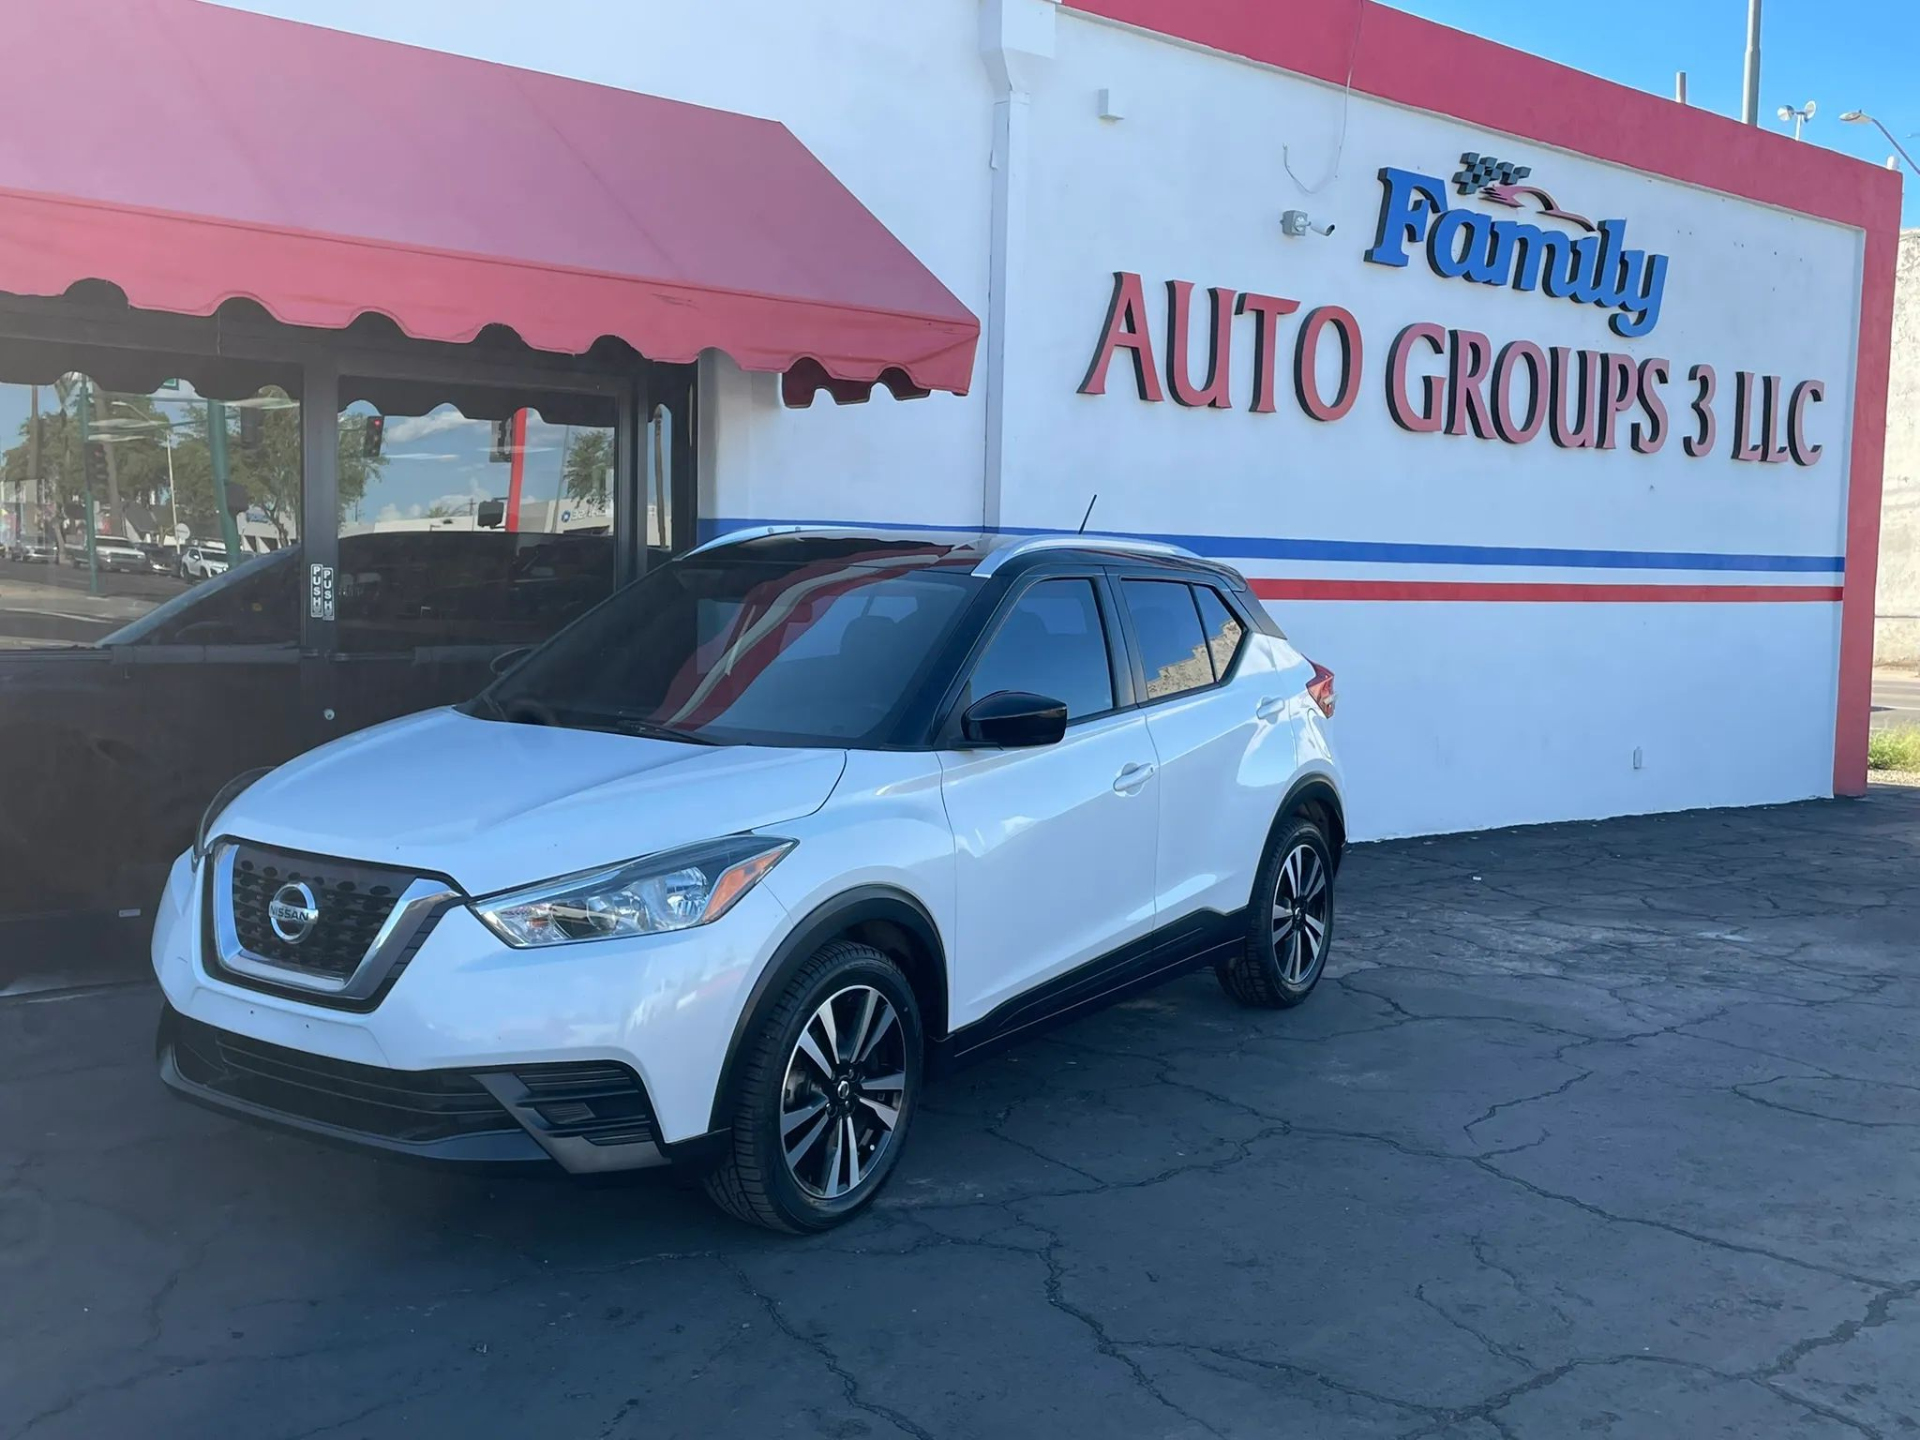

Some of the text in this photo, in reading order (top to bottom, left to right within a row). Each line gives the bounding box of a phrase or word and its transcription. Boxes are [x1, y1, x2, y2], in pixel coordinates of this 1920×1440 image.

[1364, 167, 1669, 337] Family
[1077, 271, 1825, 466] AUTO GROUPS 3 LLC
[312, 565, 321, 607] PUSH
[323, 569, 333, 611] PUSH
[270, 904, 309, 921] NISSAN
